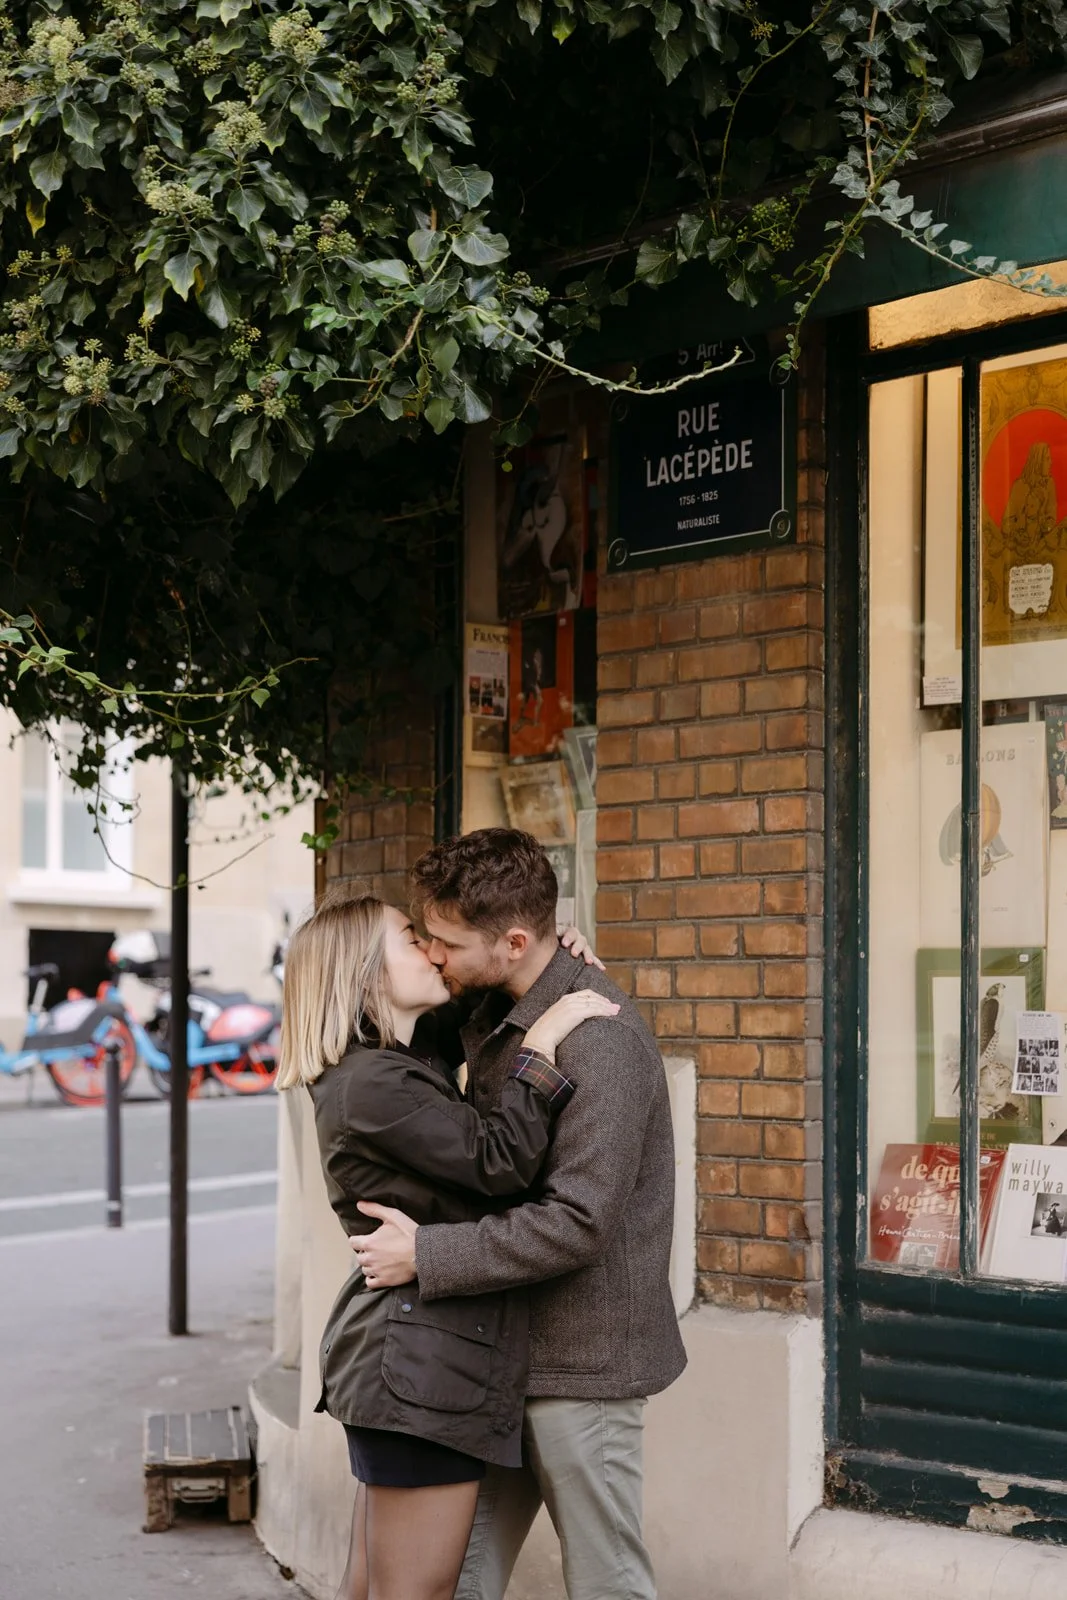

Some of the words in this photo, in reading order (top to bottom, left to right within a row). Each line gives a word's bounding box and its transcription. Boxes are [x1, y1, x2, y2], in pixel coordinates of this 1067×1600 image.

[677, 402, 720, 438] RUE
[646, 439, 753, 487] LACÉPÈDE
[679, 494, 696, 507] 1756
[701, 490, 719, 502] 1825
[677, 514, 721, 531] NATURALISTE
[901, 1155, 928, 1180] de
[1011, 1158, 1051, 1181] willy
[1008, 1178, 1064, 1196] maywa
